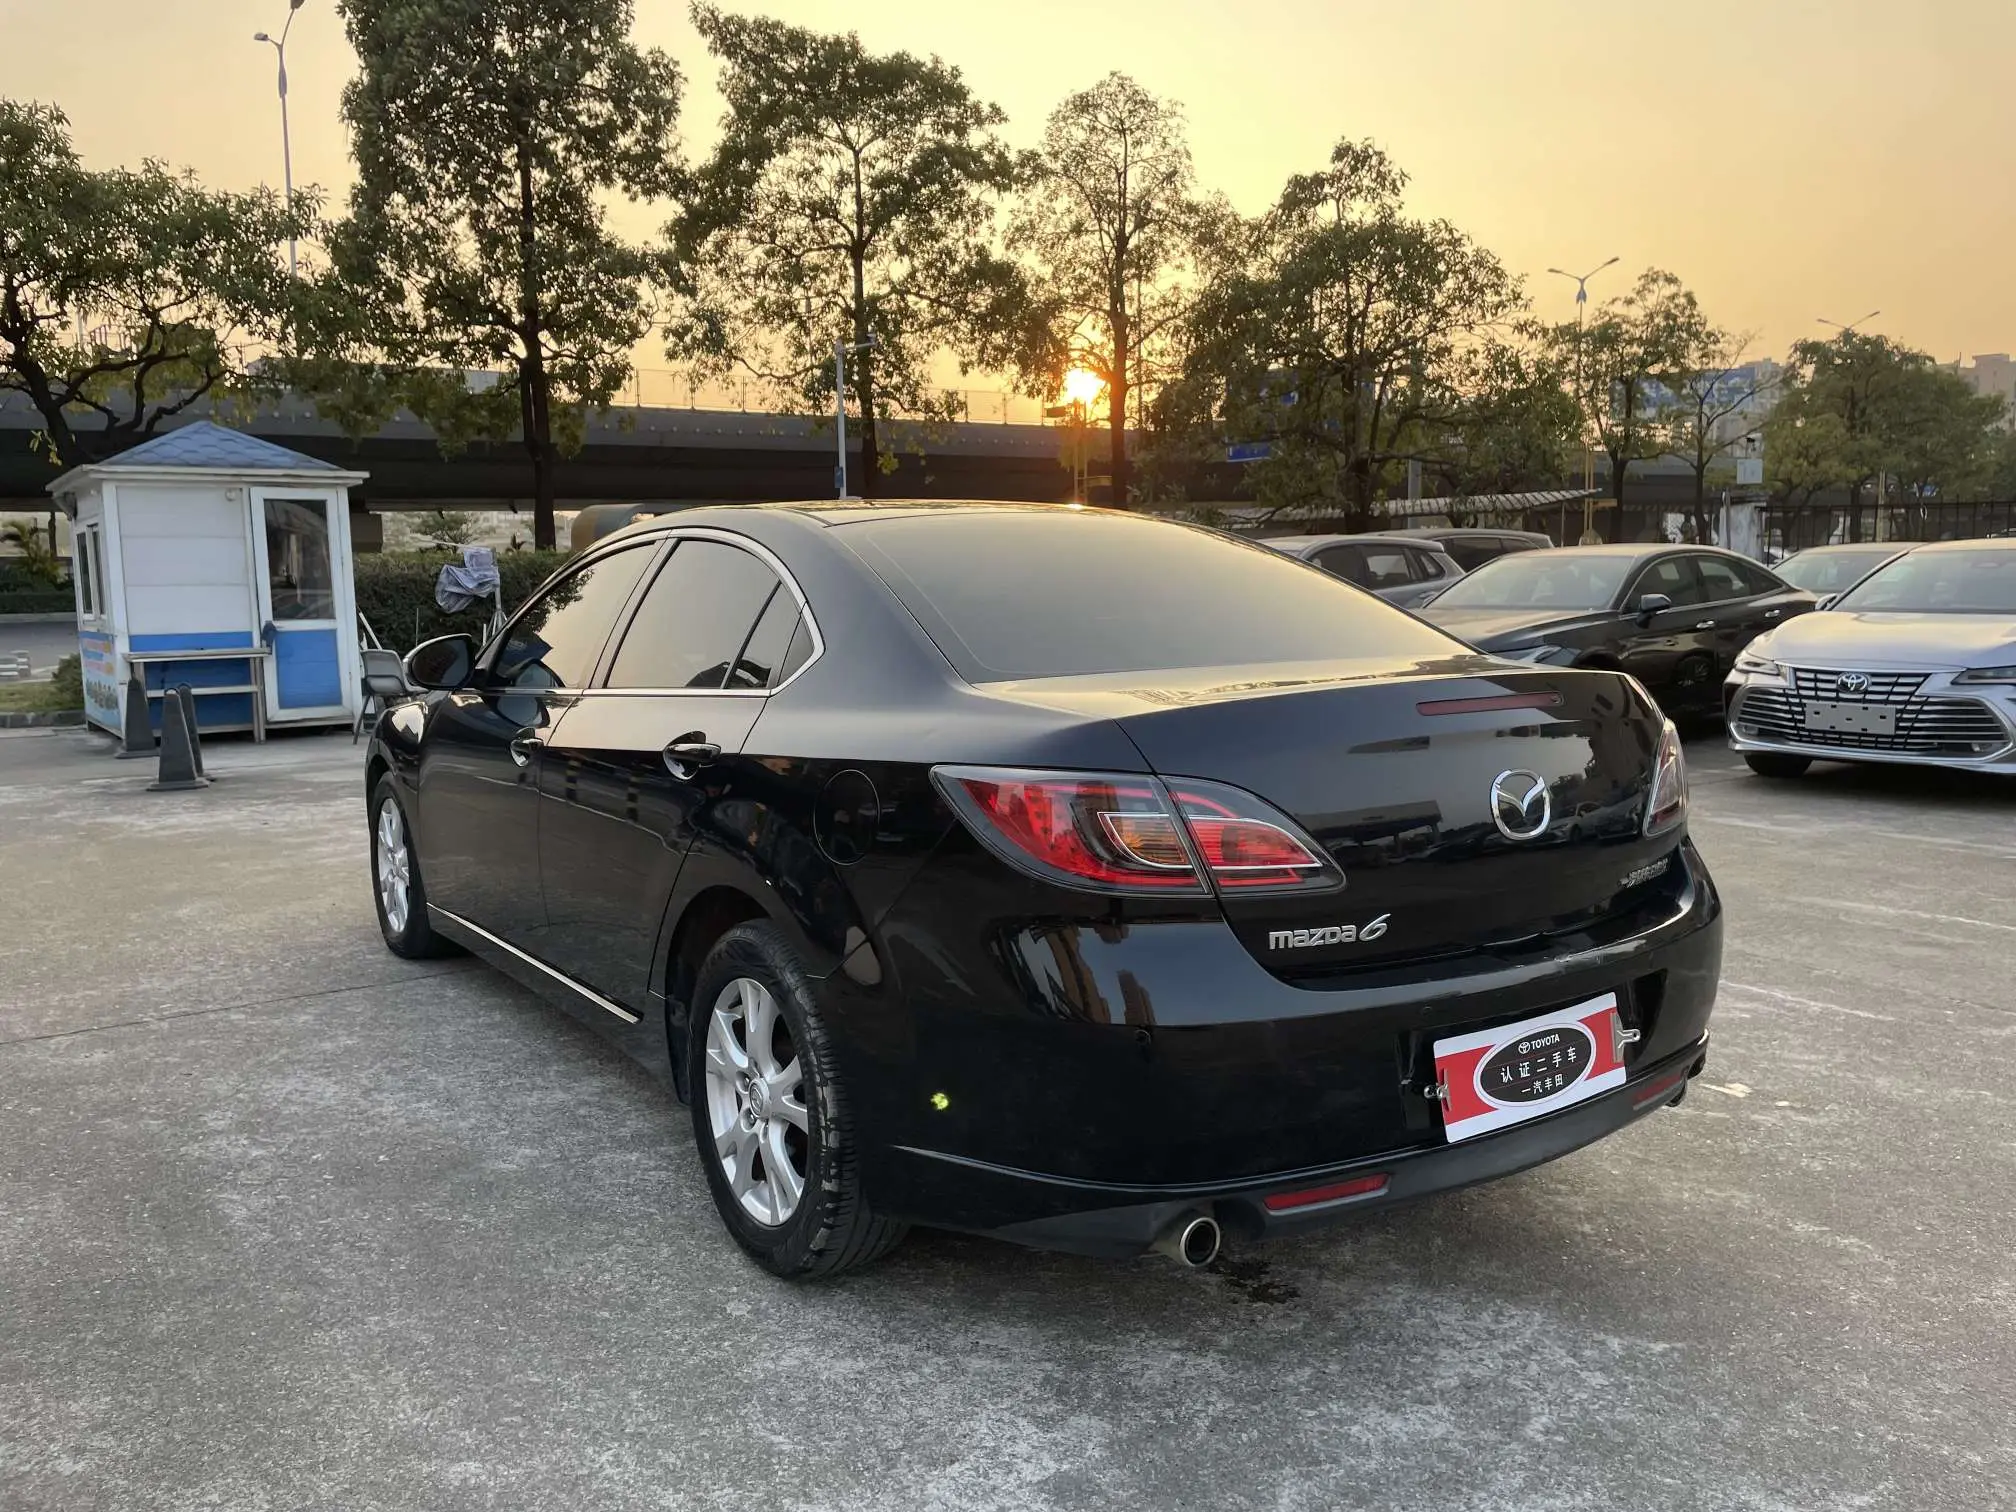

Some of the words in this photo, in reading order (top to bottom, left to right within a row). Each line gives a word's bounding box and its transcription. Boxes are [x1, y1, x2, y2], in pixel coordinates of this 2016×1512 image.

[1531, 1034, 1560, 1050] TOYOTA
[1501, 1046, 1577, 1083] 认证二手车
[1521, 1074, 1563, 1094] 一汽丰田
